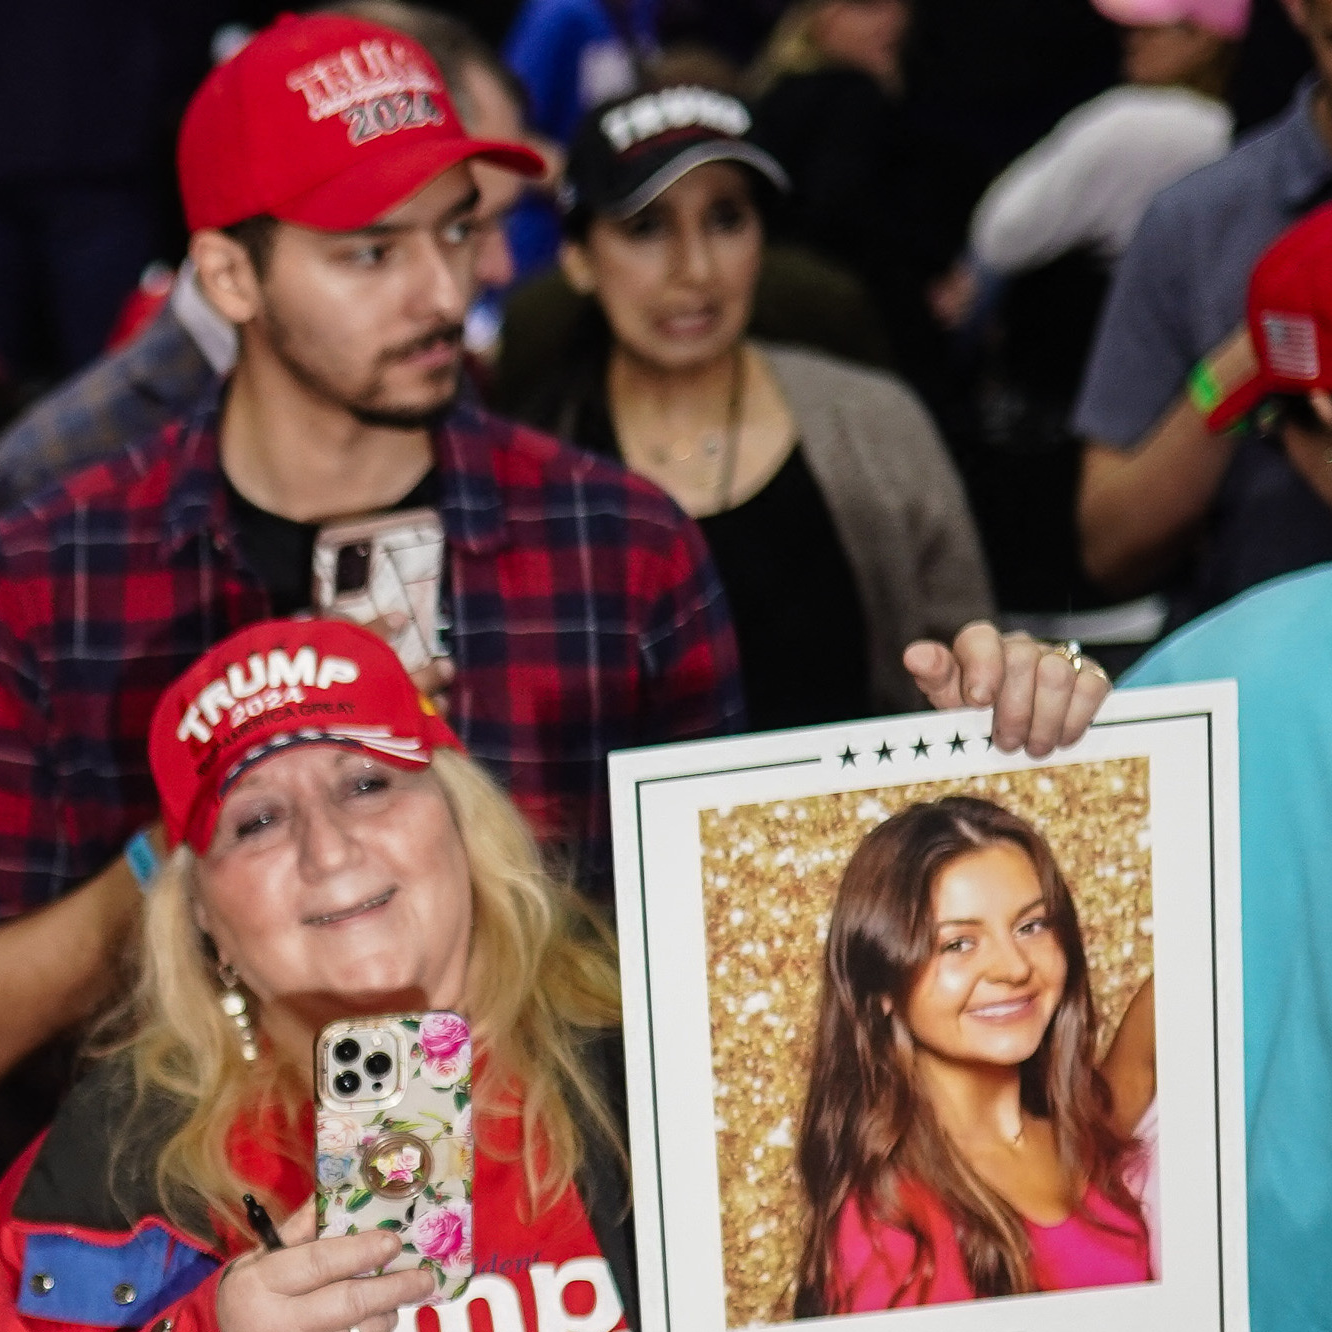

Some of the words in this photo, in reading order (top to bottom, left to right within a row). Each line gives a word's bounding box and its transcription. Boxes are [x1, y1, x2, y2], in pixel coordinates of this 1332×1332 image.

[176, 645, 360, 743] TRUMP
[229, 685, 308, 729] 2024
[298, 703, 356, 716] GREAT
[471, 1251, 541, 1276] ident
